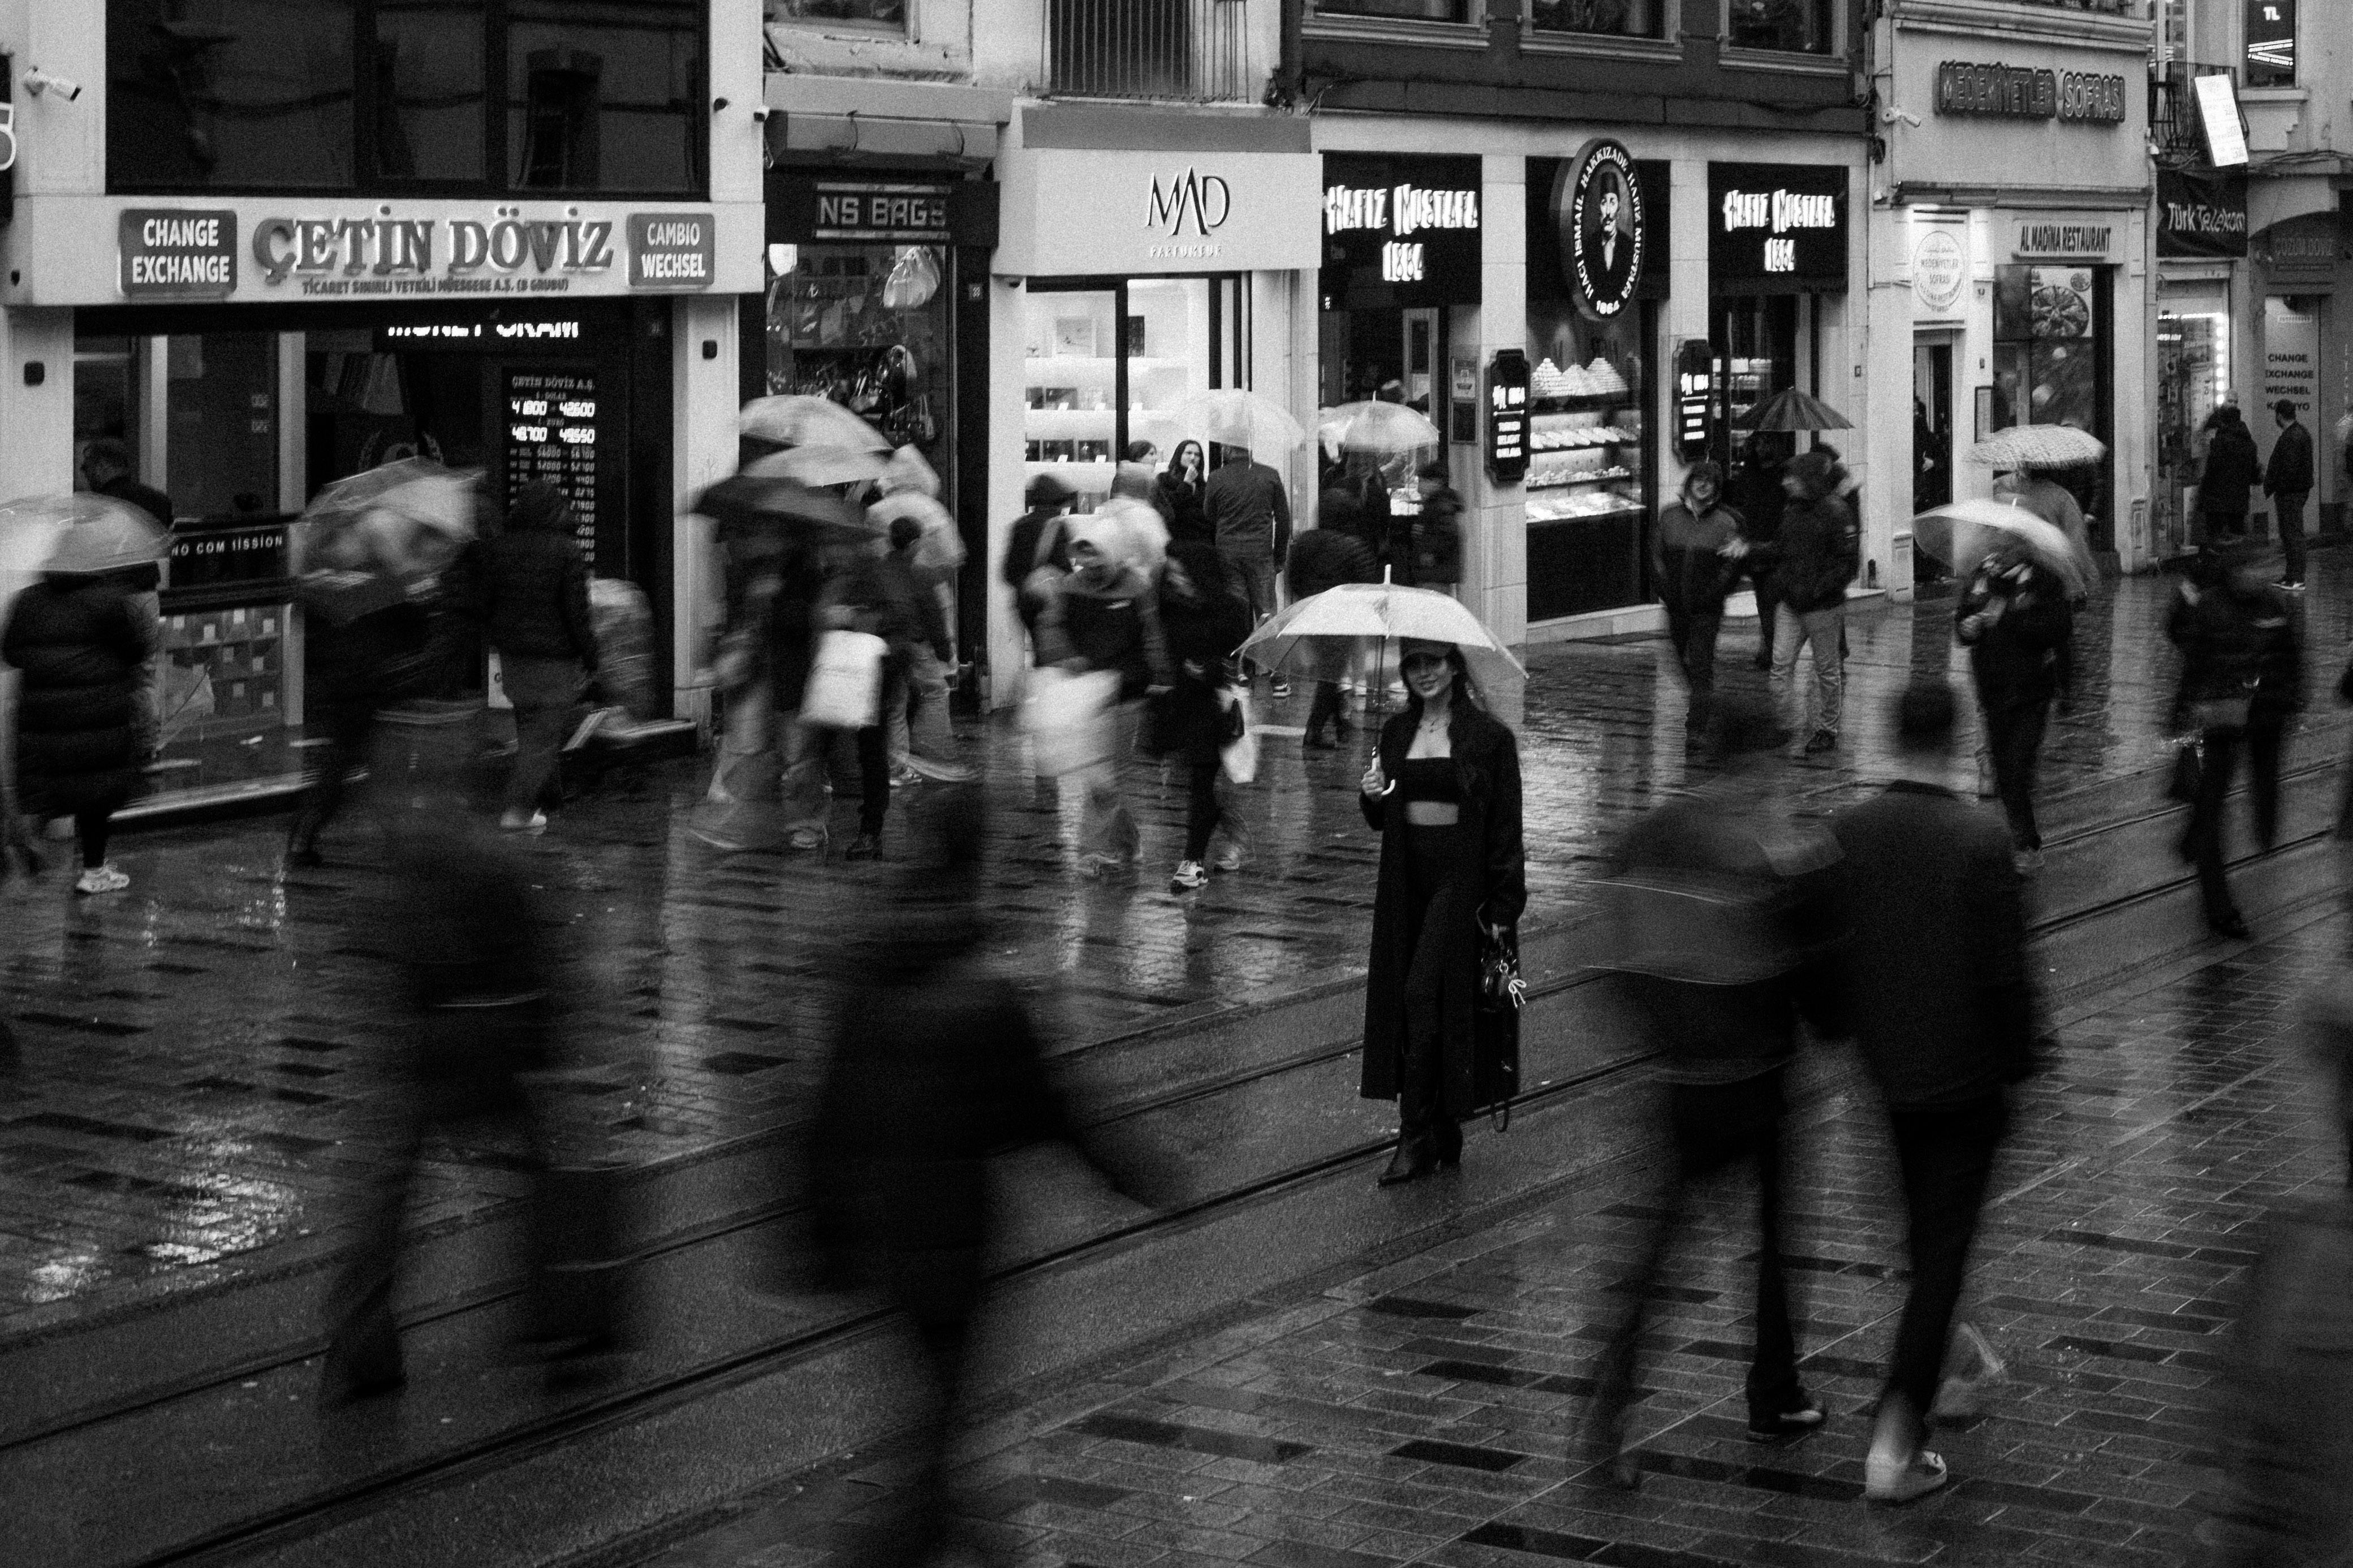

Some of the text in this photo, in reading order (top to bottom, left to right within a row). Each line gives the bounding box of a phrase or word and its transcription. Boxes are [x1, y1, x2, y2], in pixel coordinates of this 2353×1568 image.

[820, 196, 946, 227] NS BAGS
[1145, 166, 1230, 236] MAD
[143, 218, 219, 247] CHANGE
[252, 205, 615, 287] ÇETİN DÖVİZ
[646, 222, 701, 247] CAMBIO
[2062, 226, 2111, 253] RESTAURANT
[132, 255, 230, 284] EXCHANGE
[640, 253, 706, 279] WECHSEL
[2268, 353, 2308, 363] CHANGE
[2265, 369, 2314, 379] EXCHANGE
[2265, 385, 2311, 395] WECHSEL
